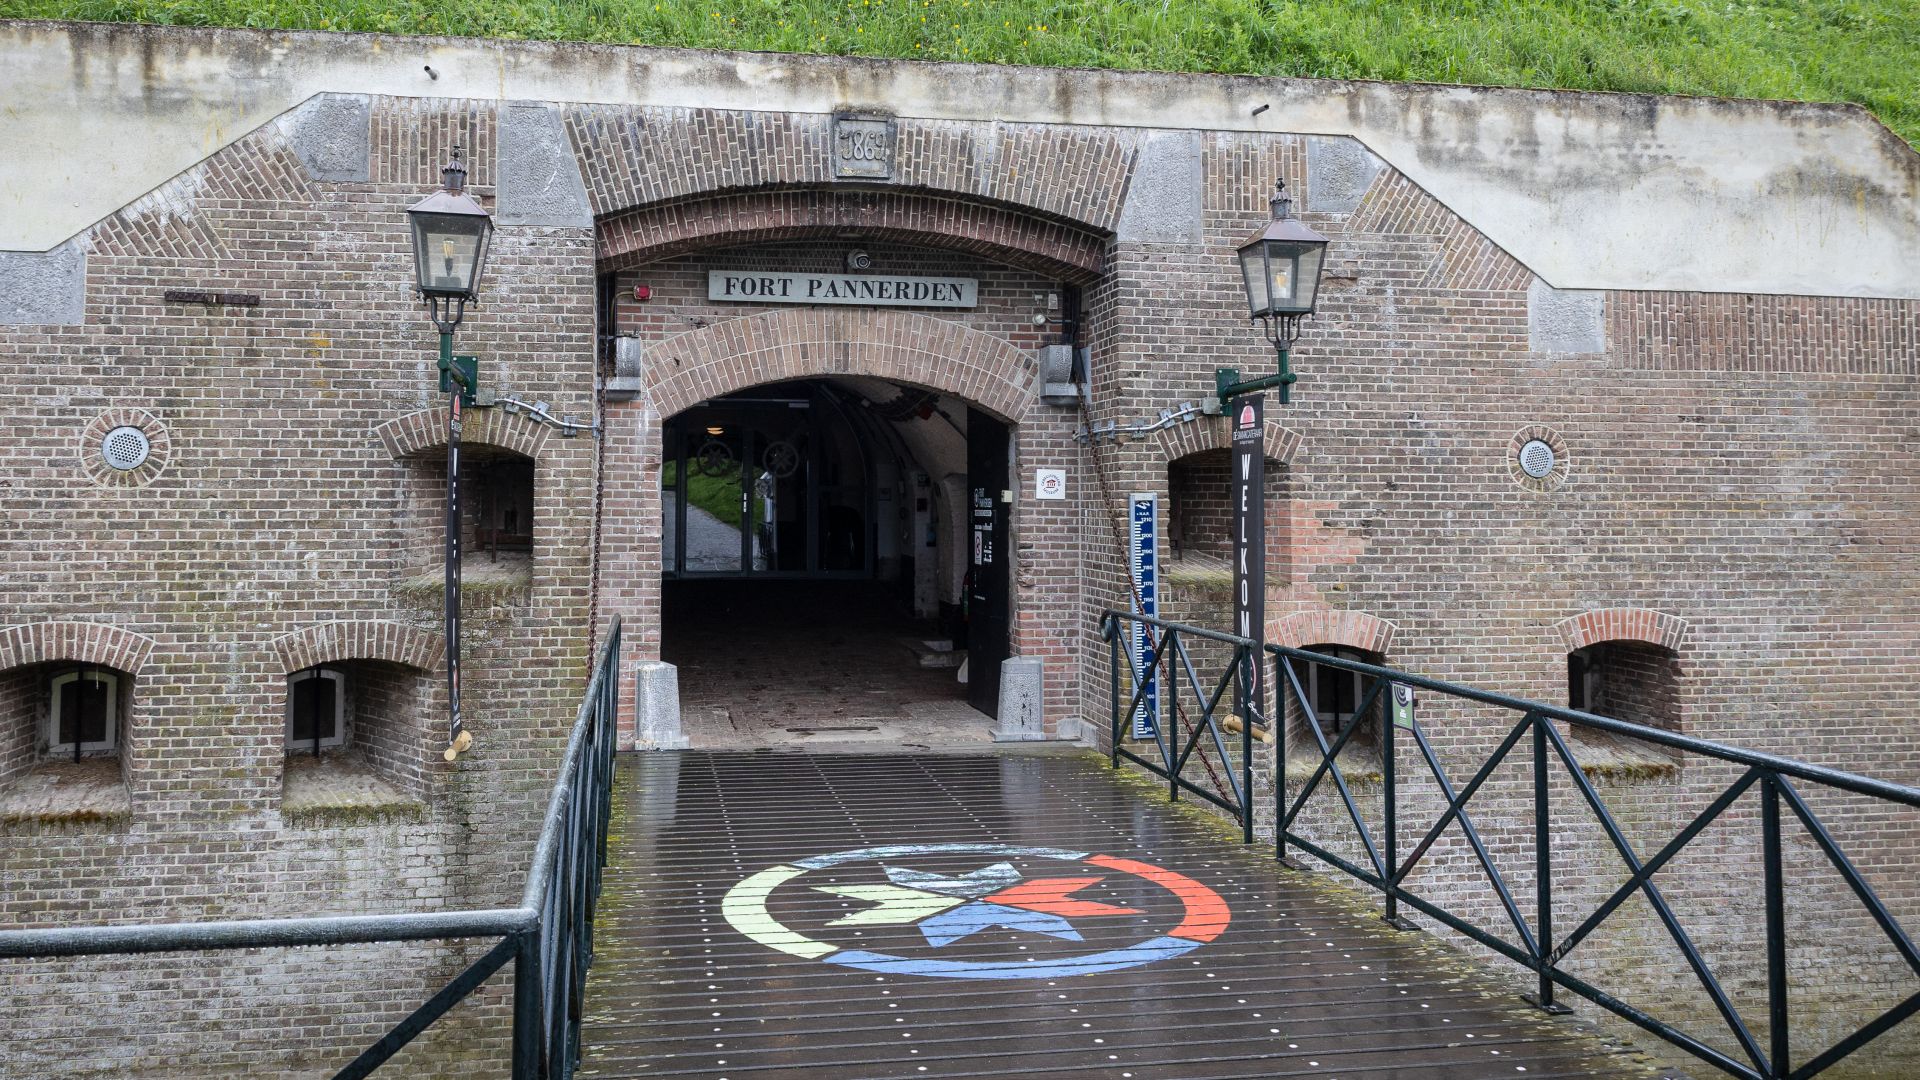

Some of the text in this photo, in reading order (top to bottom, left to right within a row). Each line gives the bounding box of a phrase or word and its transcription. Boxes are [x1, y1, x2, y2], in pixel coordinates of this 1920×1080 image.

[840, 129, 886, 161] 1869
[723, 276, 964, 302] FORT PANNERDEN
[1241, 453, 1251, 638] WELKOM
